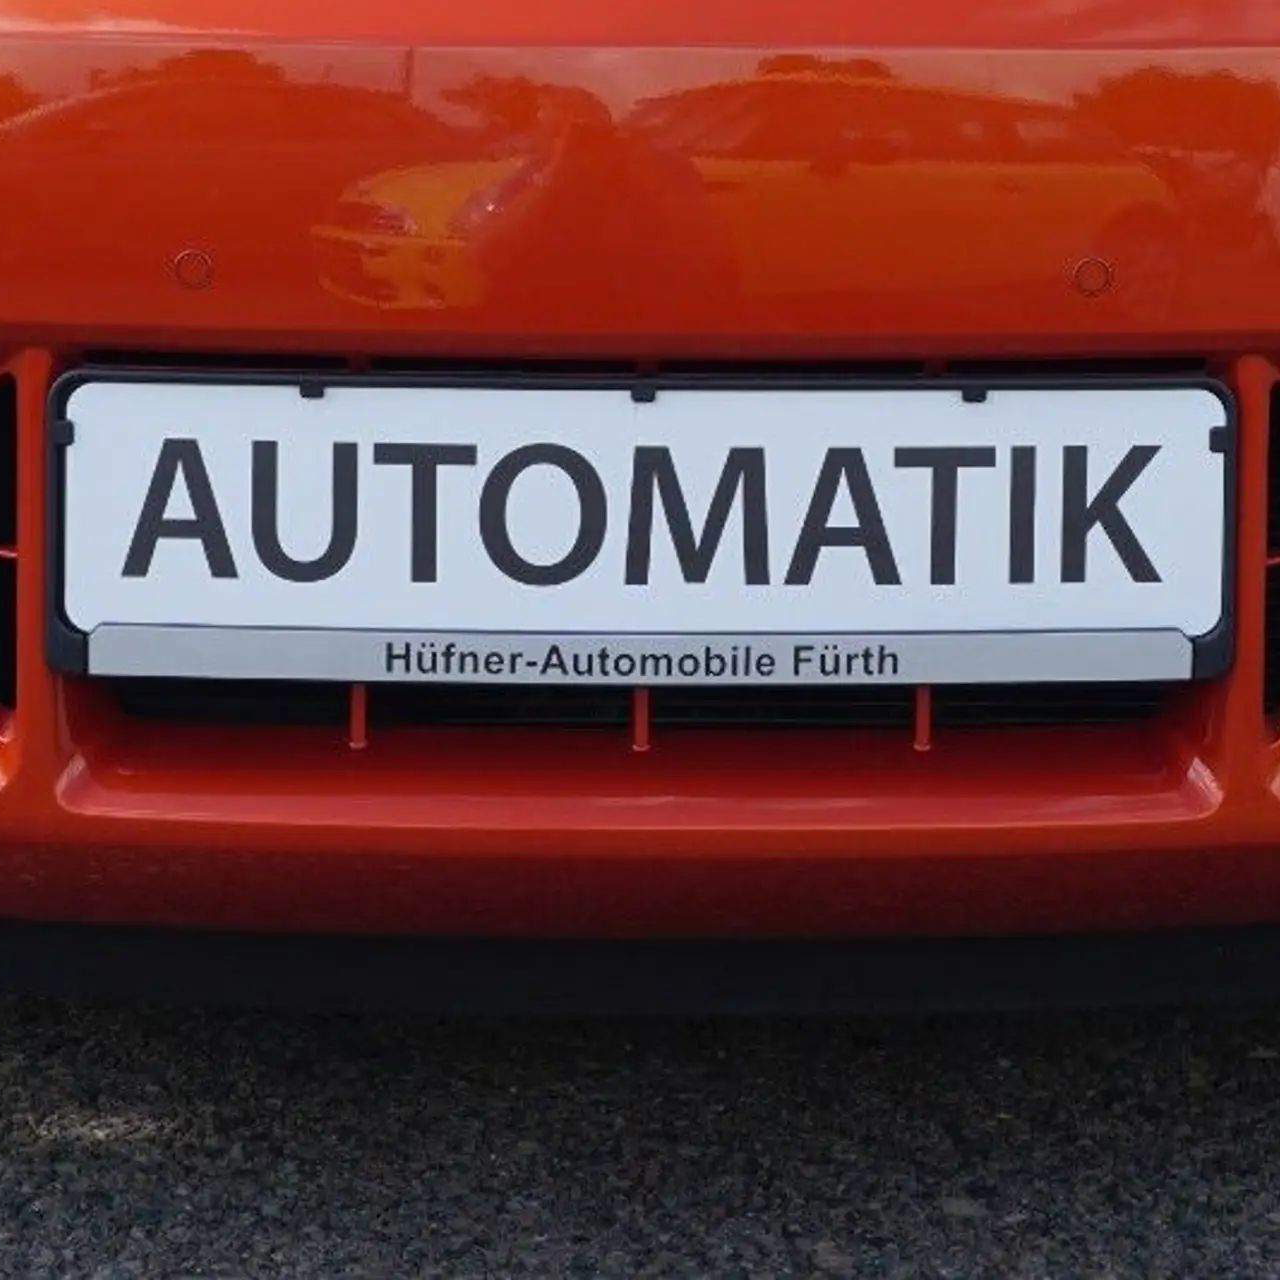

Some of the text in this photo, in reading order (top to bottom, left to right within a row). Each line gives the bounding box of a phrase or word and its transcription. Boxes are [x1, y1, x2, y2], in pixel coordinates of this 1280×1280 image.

[121, 438, 1162, 587] AUTOMATIK
[385, 641, 899, 677] Hüfner-Automobile Fürth
